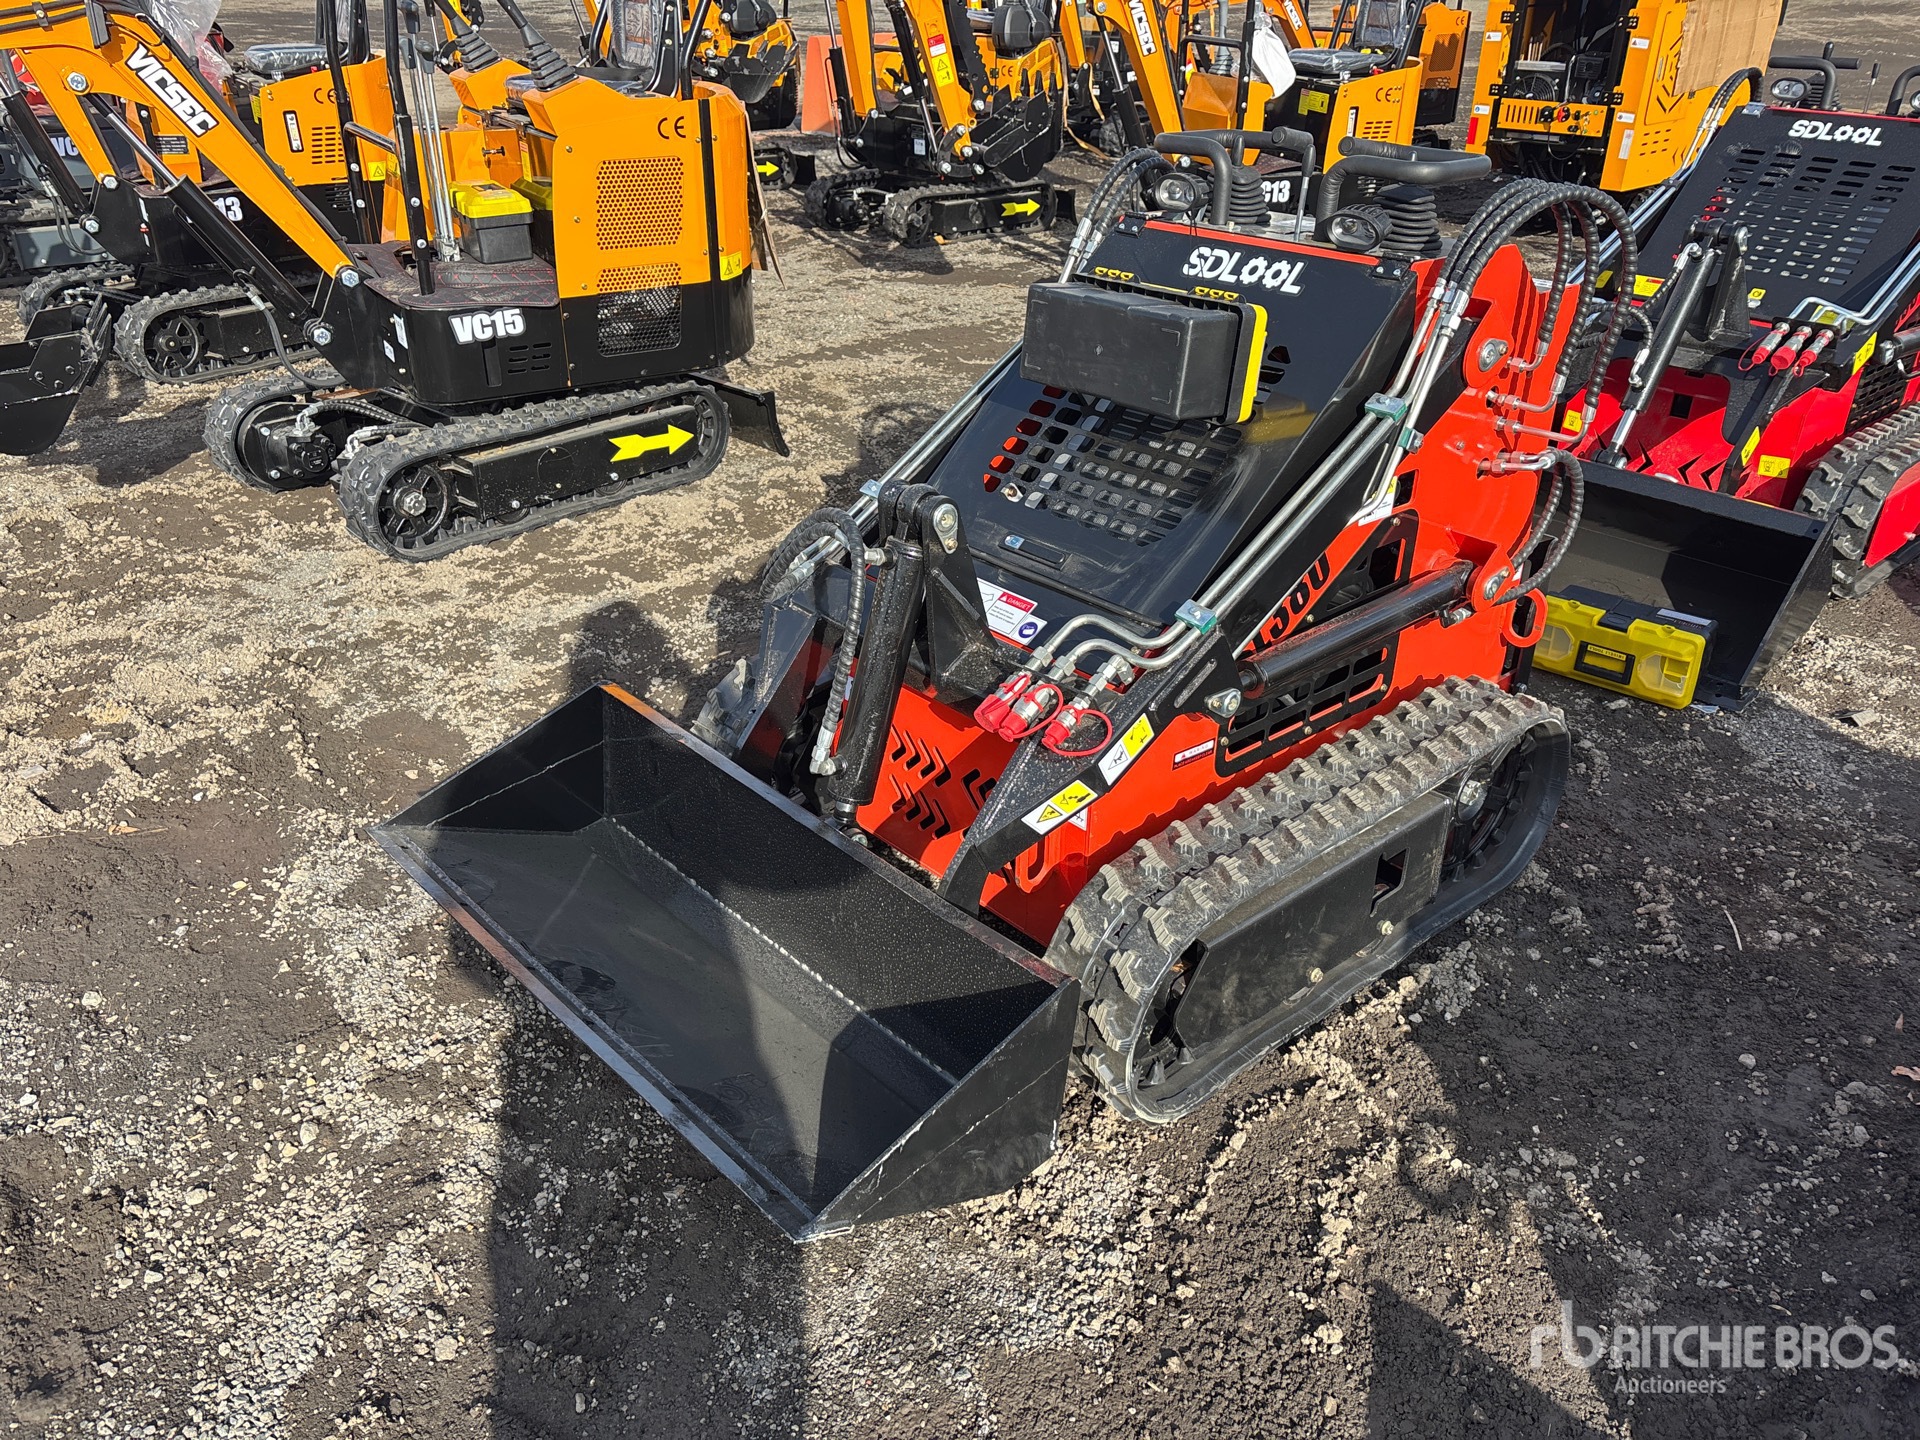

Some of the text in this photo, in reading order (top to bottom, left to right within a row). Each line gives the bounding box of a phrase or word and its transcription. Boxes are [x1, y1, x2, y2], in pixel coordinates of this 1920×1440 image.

[1128, 0, 1157, 56] VICSEC
[1001, 65, 1014, 77] CE
[126, 42, 219, 137] VICSEC
[1375, 87, 1394, 103] CE
[658, 116, 686, 139] CE
[1787, 119, 1883, 147] SDLOOL
[1261, 180, 1291, 203] C13
[212, 196, 243, 222] 13
[1182, 245, 1305, 295] SDLOOL
[449, 307, 526, 344] VC15
